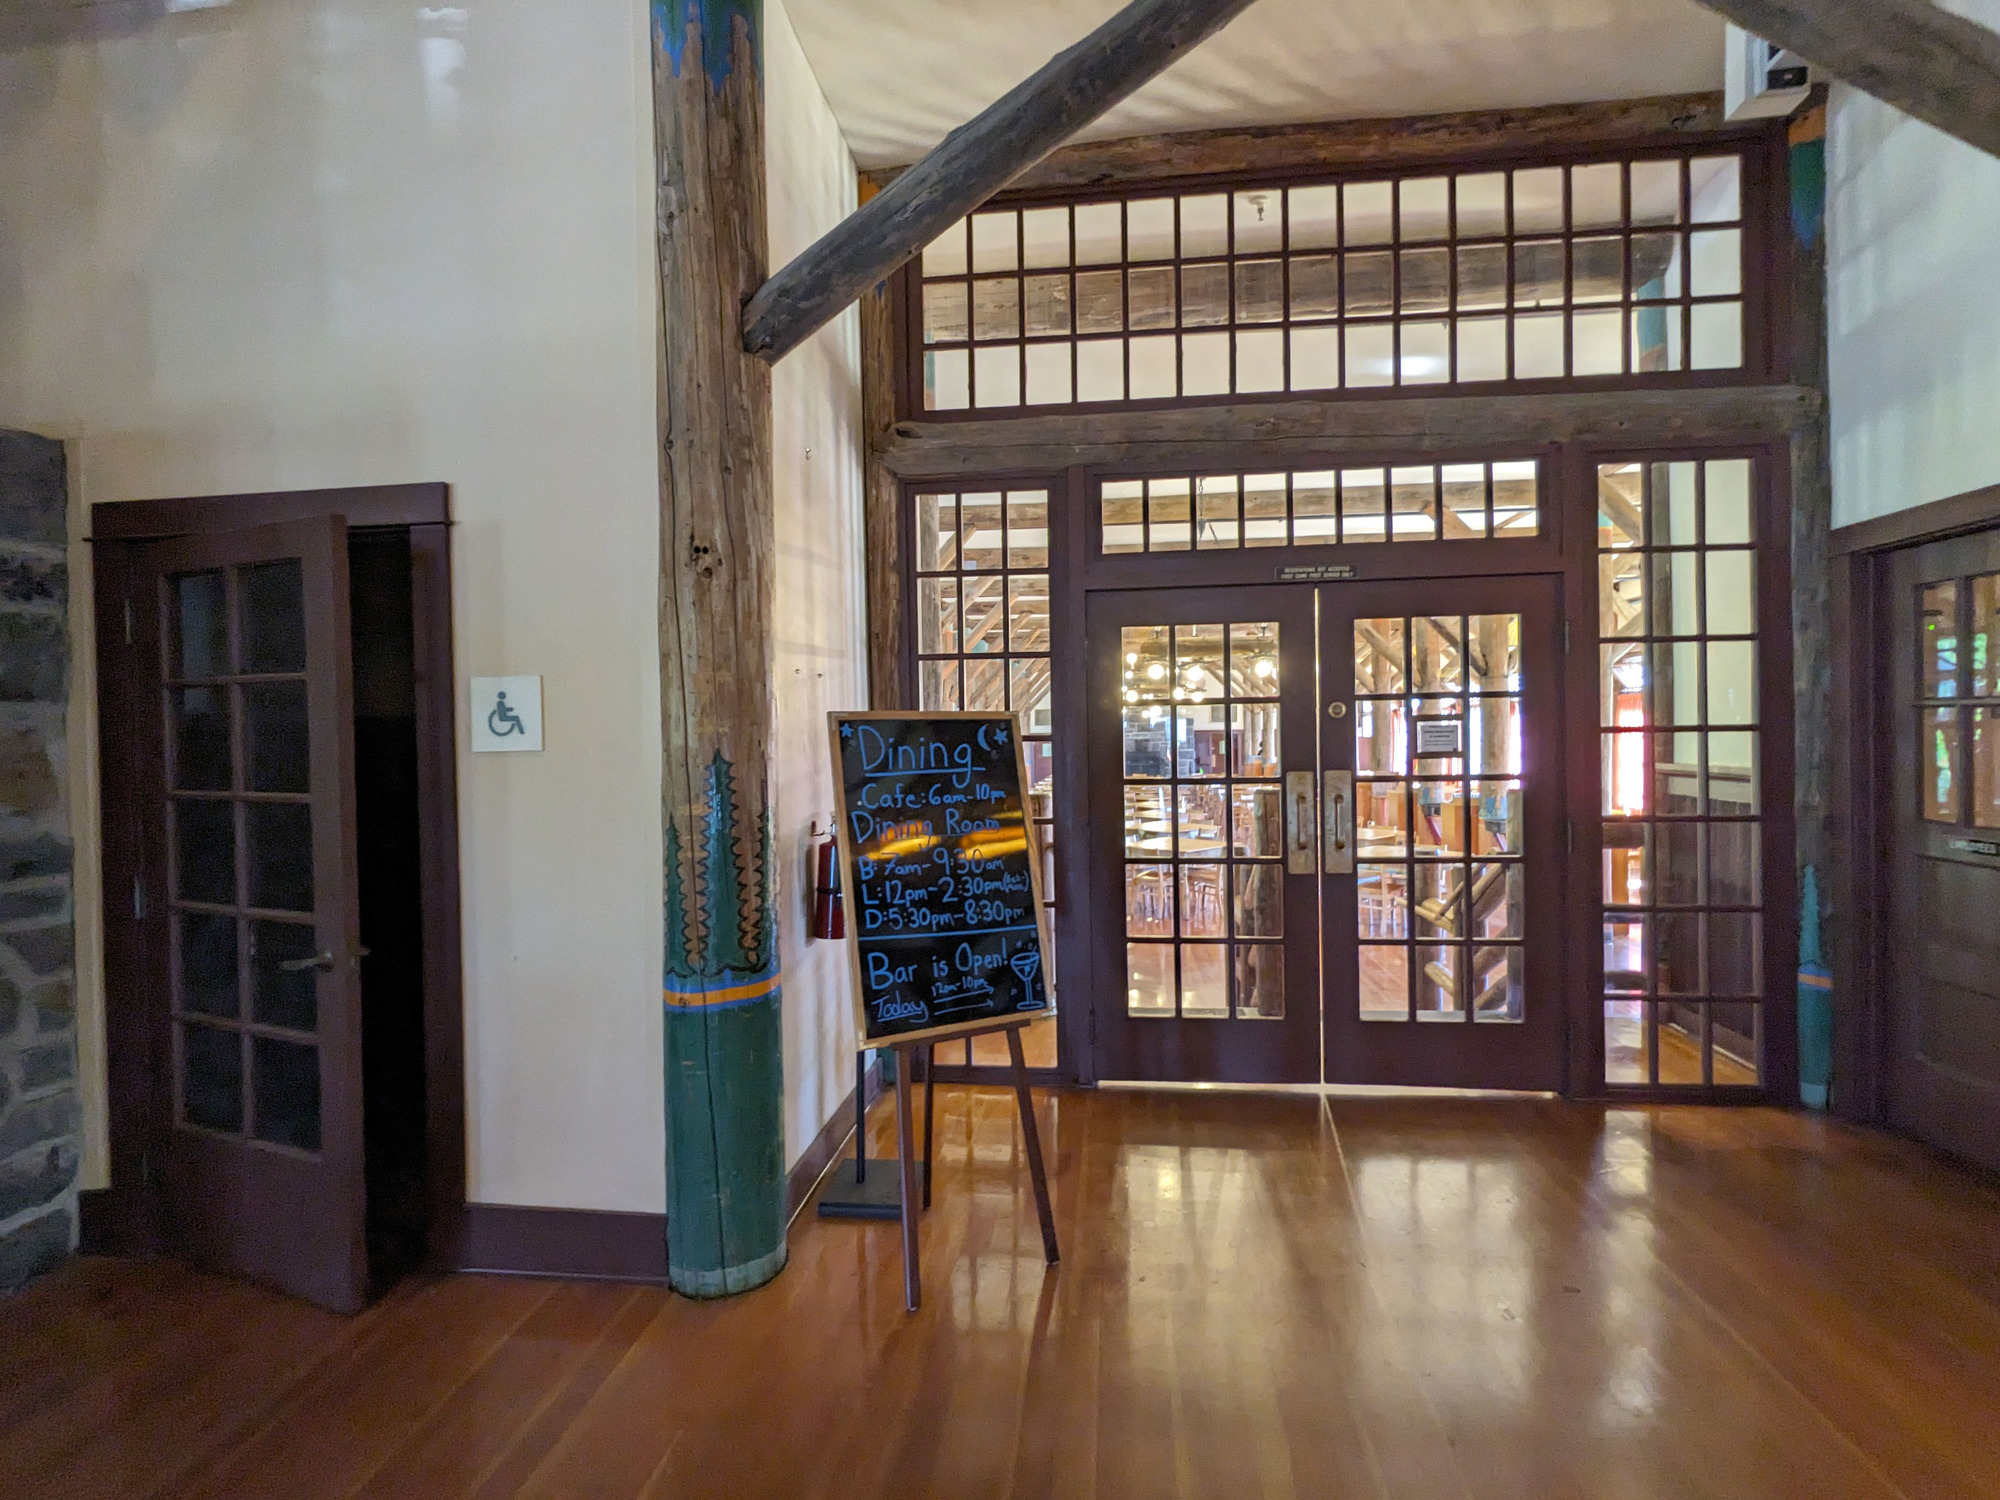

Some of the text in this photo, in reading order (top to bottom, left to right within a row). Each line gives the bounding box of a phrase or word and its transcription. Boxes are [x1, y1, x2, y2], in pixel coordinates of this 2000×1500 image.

[858, 725, 972, 788] Dining
[851, 808, 1001, 852] Dining Room
[857, 855, 878, 881] B:
[867, 937, 1008, 990] Bar is Open!
[871, 990, 930, 1023] Today
